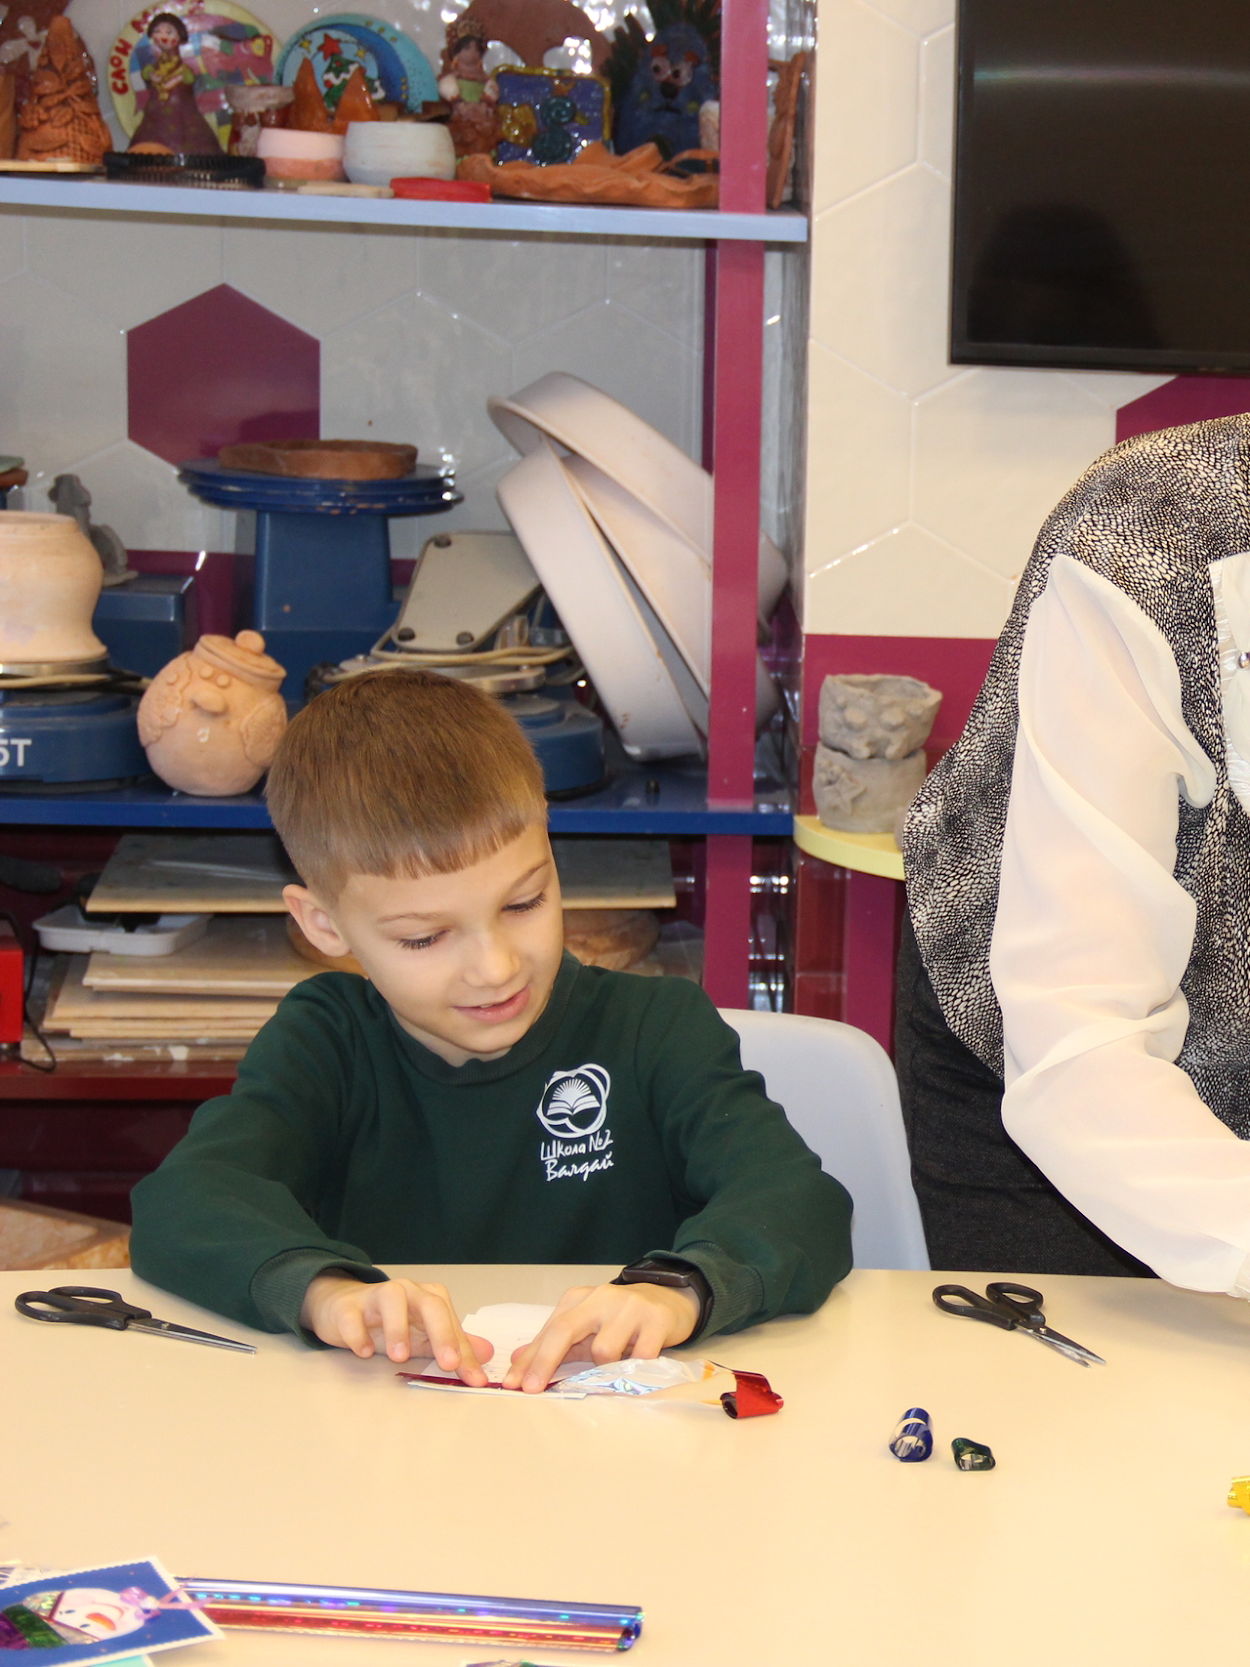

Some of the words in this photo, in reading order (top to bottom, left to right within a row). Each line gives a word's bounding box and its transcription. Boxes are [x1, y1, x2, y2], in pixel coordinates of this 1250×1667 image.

[109, 38, 132, 95] СЛОН
[541, 1140, 586, 1161] Школа
[589, 1129, 613, 1151] №2
[545, 1151, 614, 1181] Валдай
